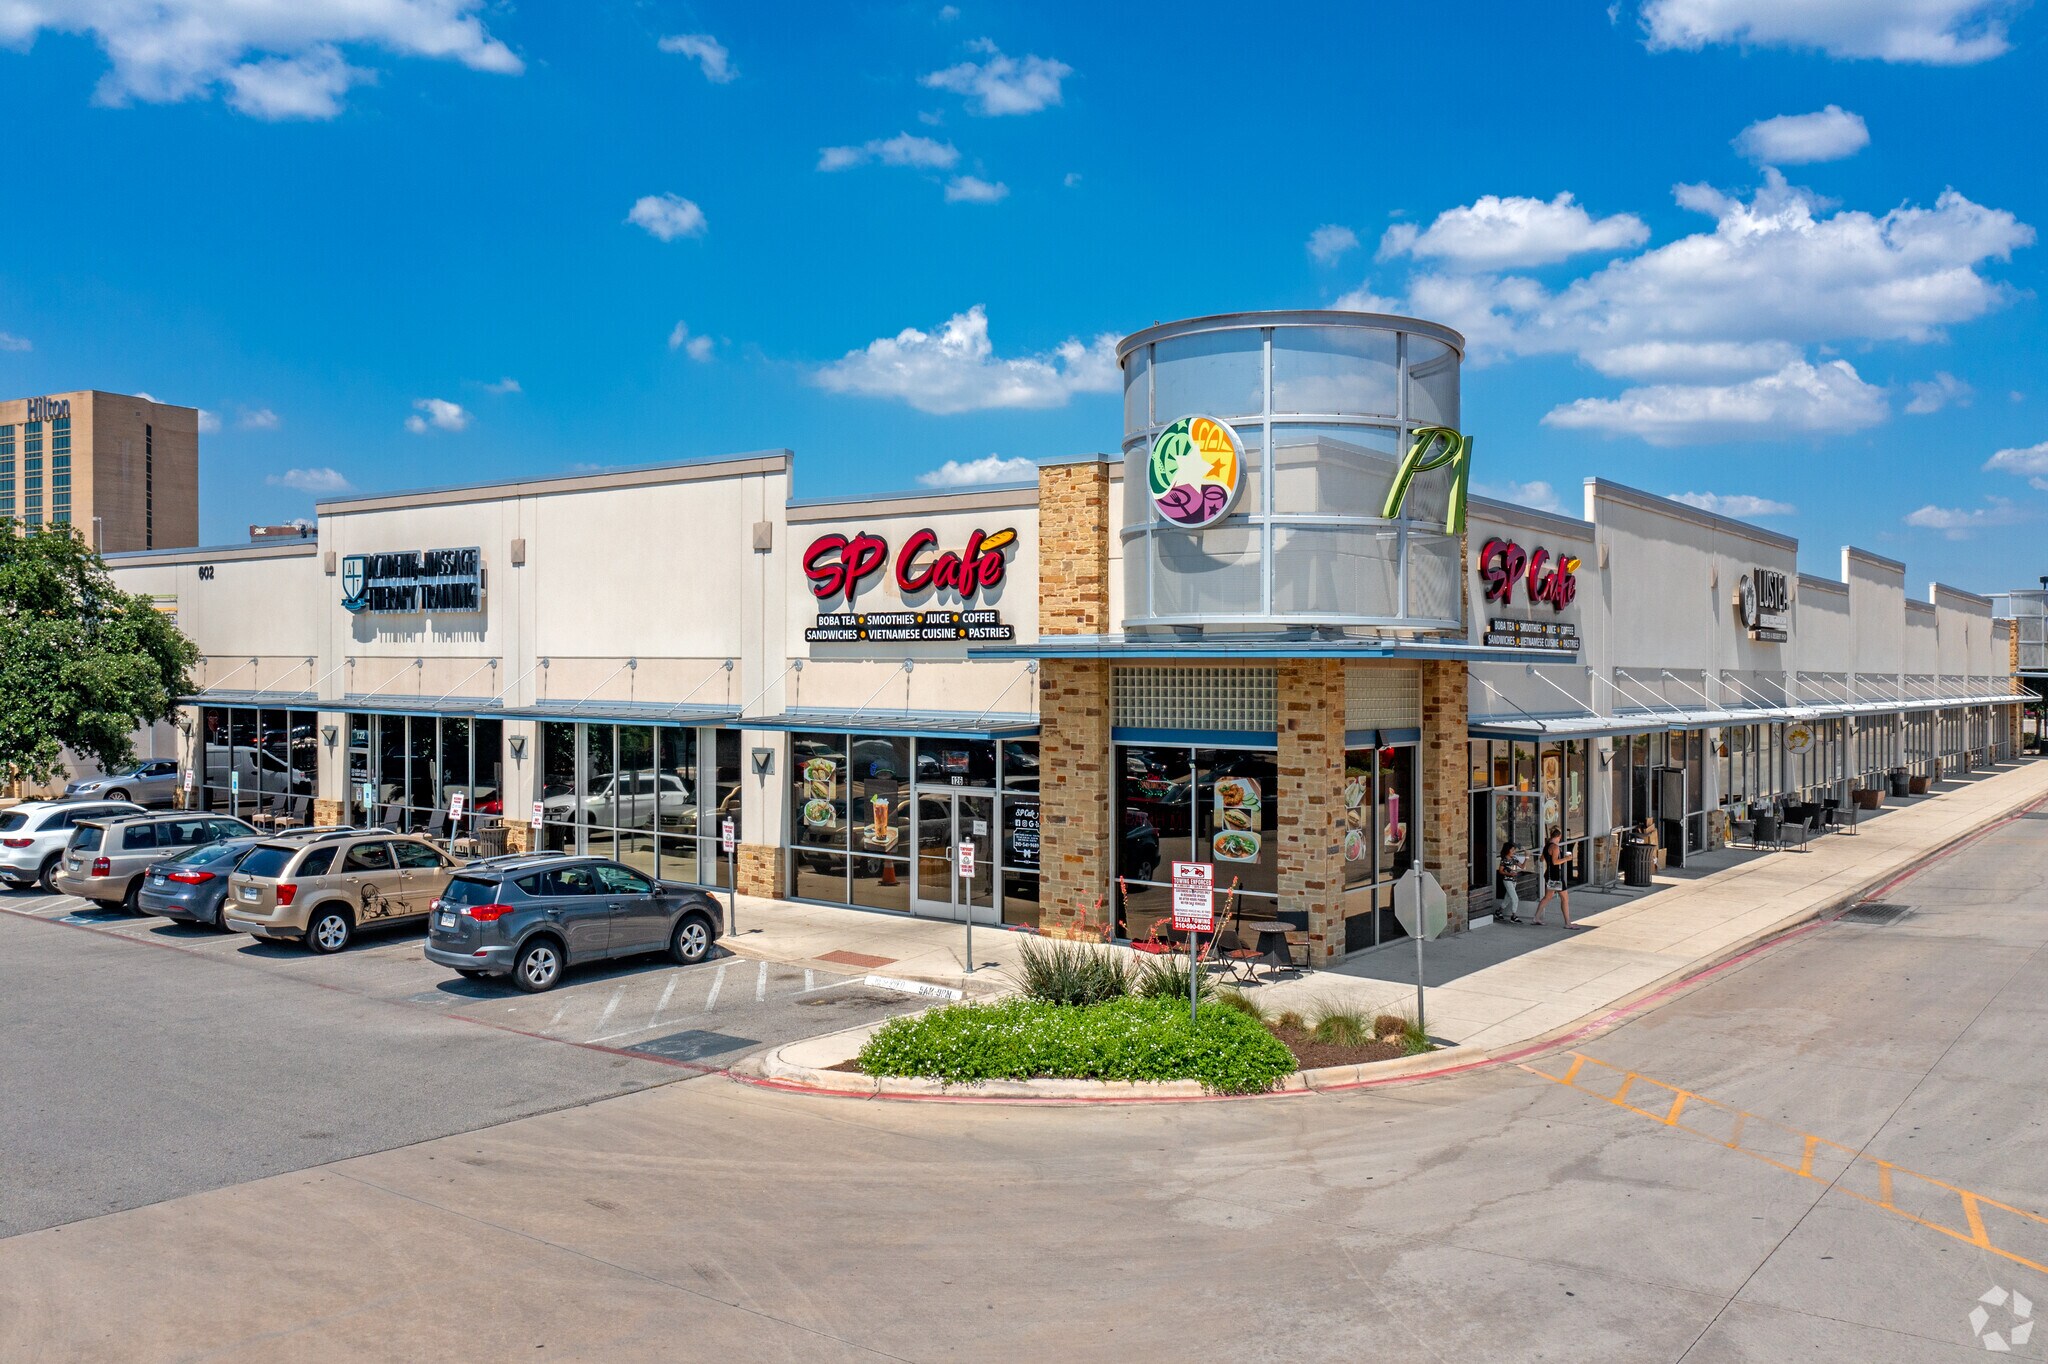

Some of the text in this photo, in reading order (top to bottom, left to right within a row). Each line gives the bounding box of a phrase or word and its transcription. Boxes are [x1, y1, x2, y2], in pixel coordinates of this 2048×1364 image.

[27, 396, 71, 420] Hilton
[424, 550, 478, 577] MASSAGE
[802, 530, 889, 602] SP
[198, 565, 215, 581] 602
[1479, 537, 1528, 607] SP
[368, 583, 478, 610] THERAPY TRAINING
[818, 612, 996, 626] BOBA TEA SMOOTHIES JUICE COFFEE
[806, 627, 1010, 640] SANDWICHES VIETNAMESE CUISINE PASTRIES
[1494, 621, 1574, 635] BOBA TEA SMOOTHIES JUICE COFFEE
[1488, 635, 1580, 649] SANDWICHES VIETNAMESE CUISINE PASTRIES
[951, 776, 963, 786] 126
[1190, 879, 1211, 887] ENFORCED
[1191, 917, 1211, 925] TOWING
